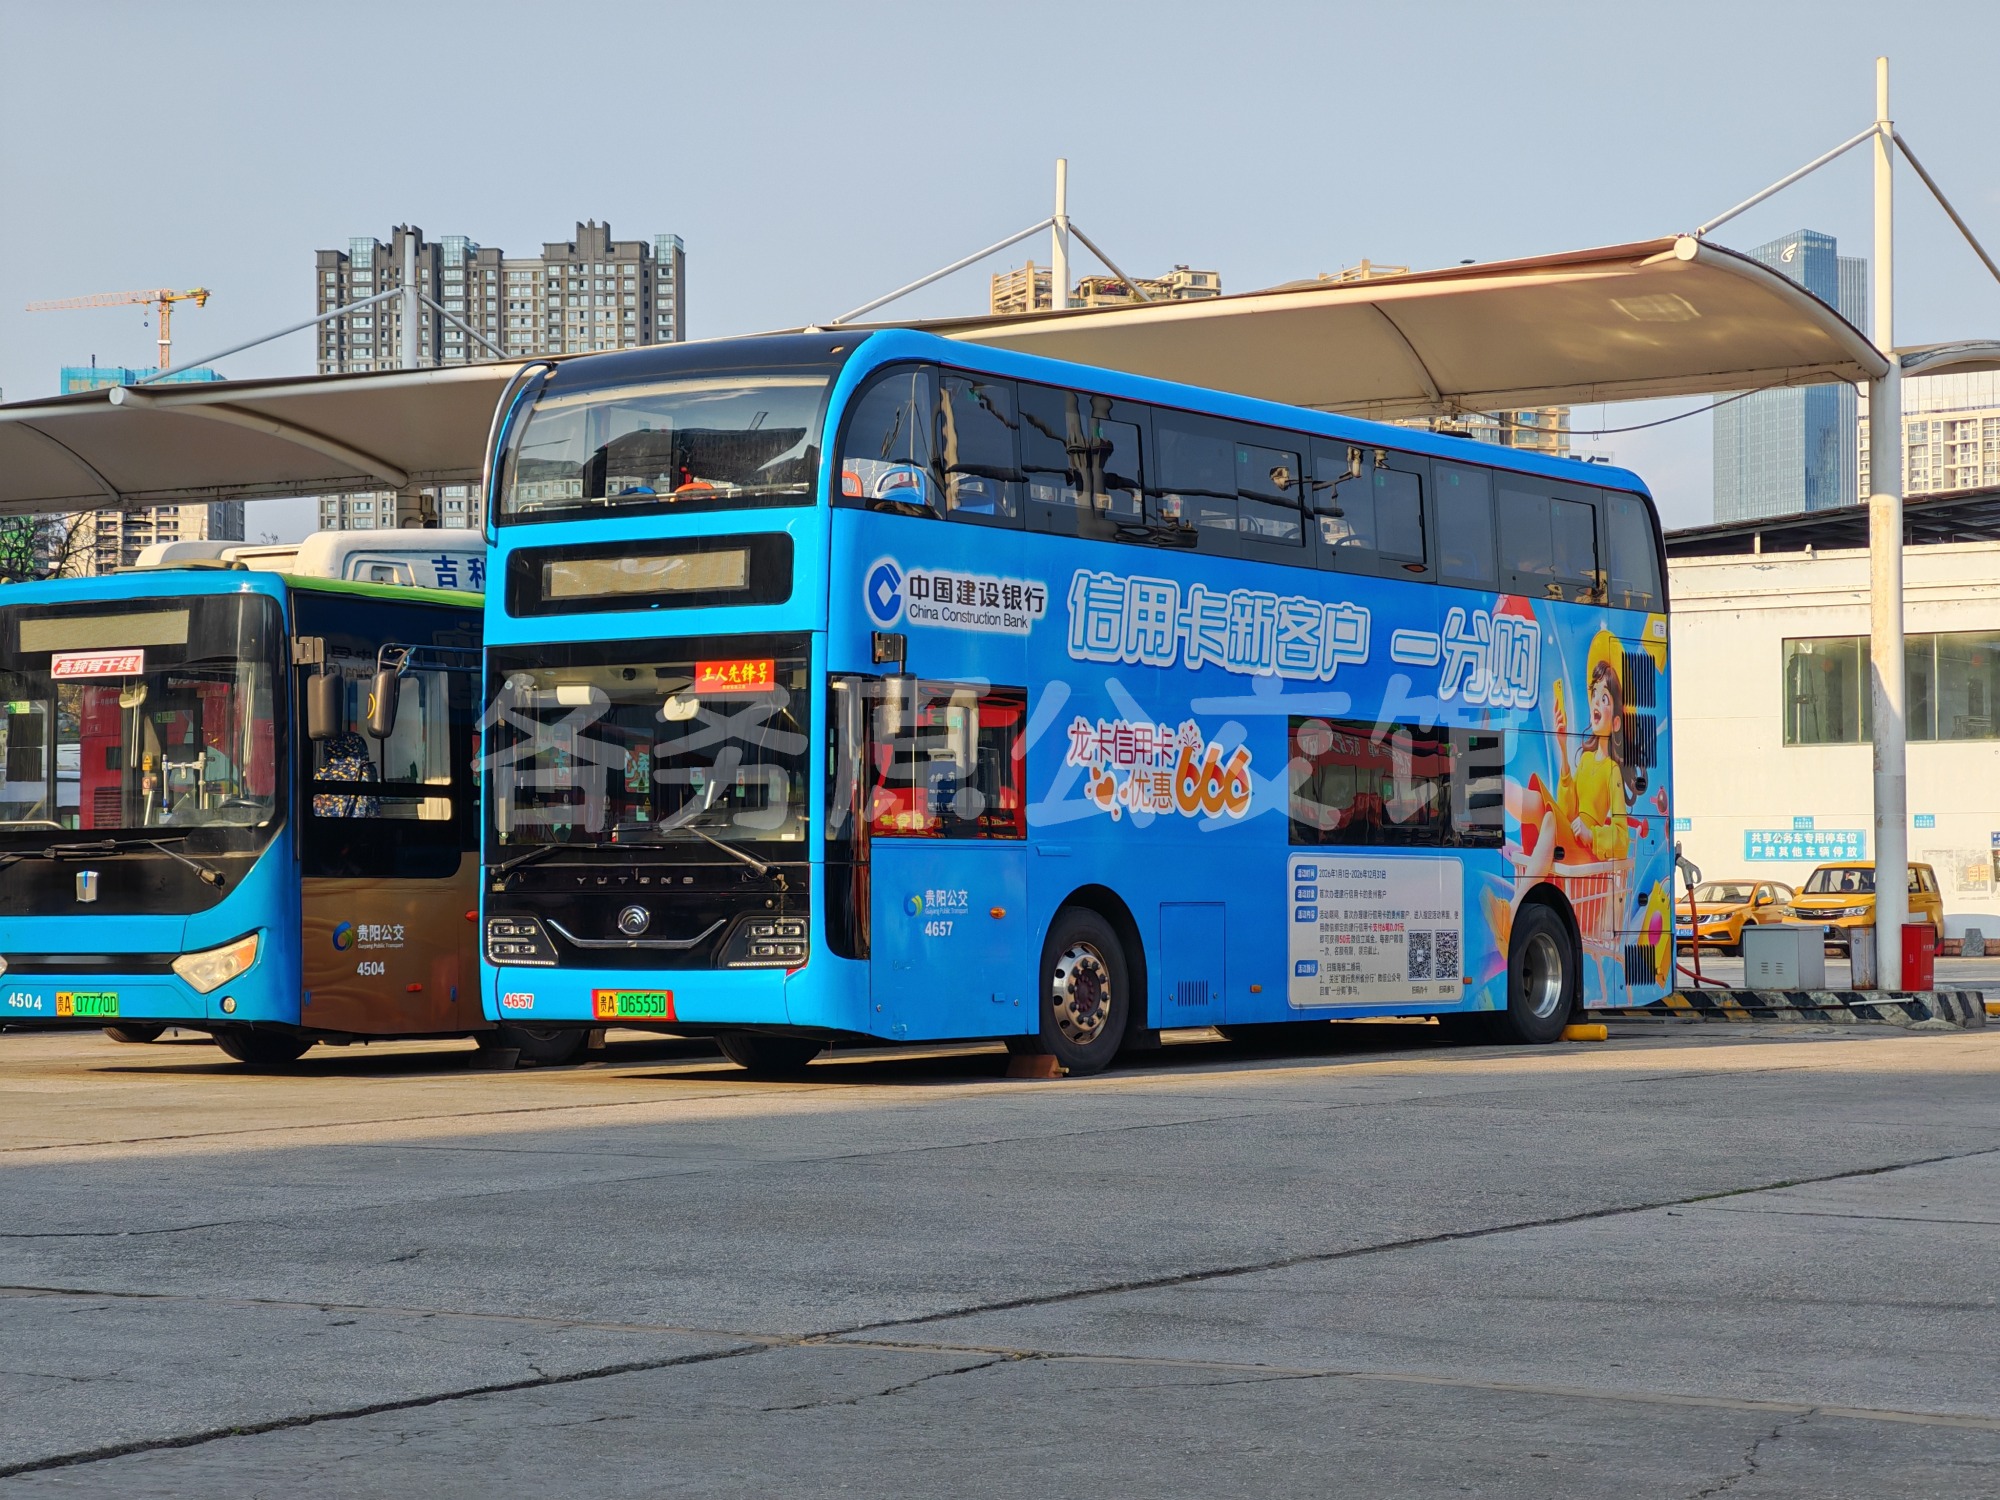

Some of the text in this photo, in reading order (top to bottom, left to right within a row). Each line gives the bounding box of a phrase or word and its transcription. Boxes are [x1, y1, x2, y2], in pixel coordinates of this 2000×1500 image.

[909, 575, 1045, 613] 中国建设银行
[909, 603, 1028, 629] China Construction Bank
[1068, 569, 1541, 708] 信用卡新客户 一分购
[56, 657, 136, 675] 高频骨干线
[702, 662, 768, 686] 工人先锋号
[1070, 721, 1173, 767] 龙卡信用卡
[1130, 768, 1173, 809] 优惠
[1176, 746, 1250, 813] 666
[1751, 832, 1858, 844] 共享公务车专用停车位
[1751, 846, 1858, 858] 严禁其他车辆停放
[577, 876, 694, 885] YUTONG
[924, 889, 968, 907] 贵阳公交
[357, 924, 404, 942] 贵阳公交
[924, 921, 953, 937] 4657
[356, 961, 385, 976] 4504
[8, 992, 42, 1010] 4504
[503, 993, 534, 1009] 4657
